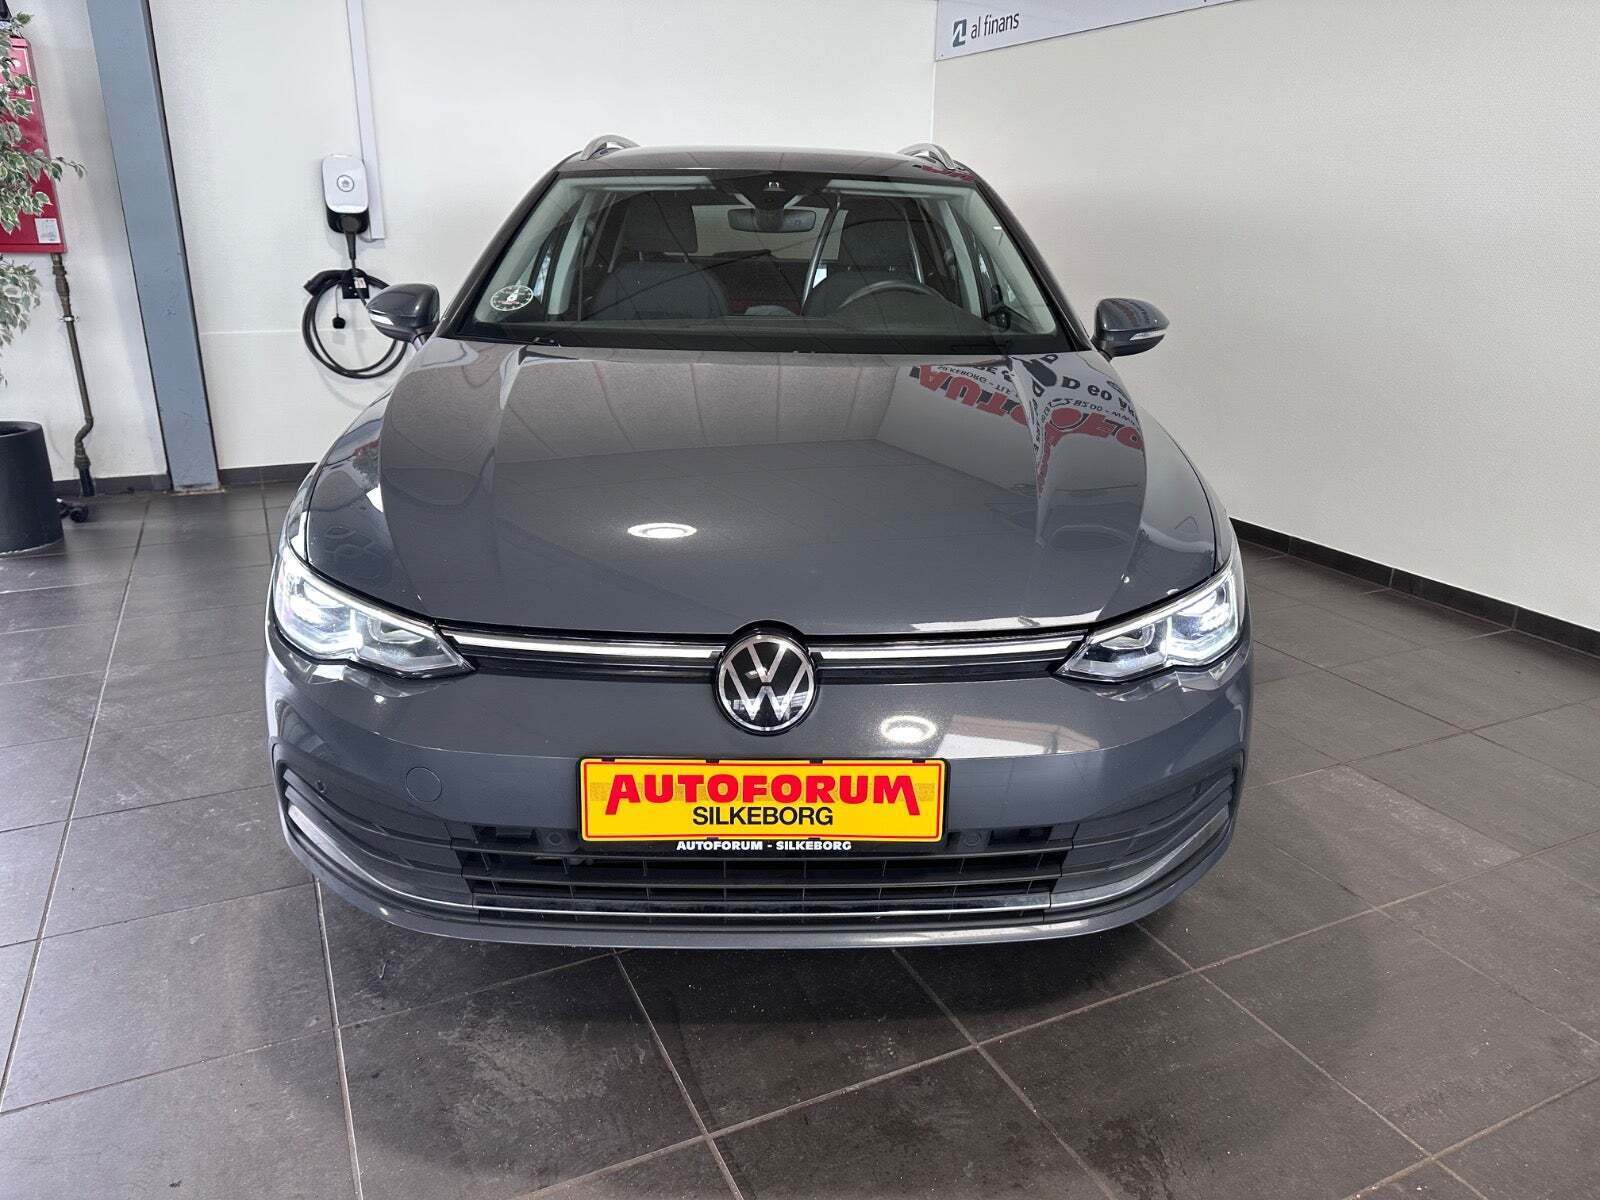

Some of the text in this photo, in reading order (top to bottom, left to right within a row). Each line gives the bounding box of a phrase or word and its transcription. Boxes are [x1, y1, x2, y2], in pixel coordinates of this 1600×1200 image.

[970, 13, 1020, 39] al finans
[604, 773, 921, 817] AUTOFORUM
[692, 806, 834, 826] SILKEBORG
[676, 841, 763, 851] AUTOFORUM
[776, 841, 852, 851] SILKEBORG
